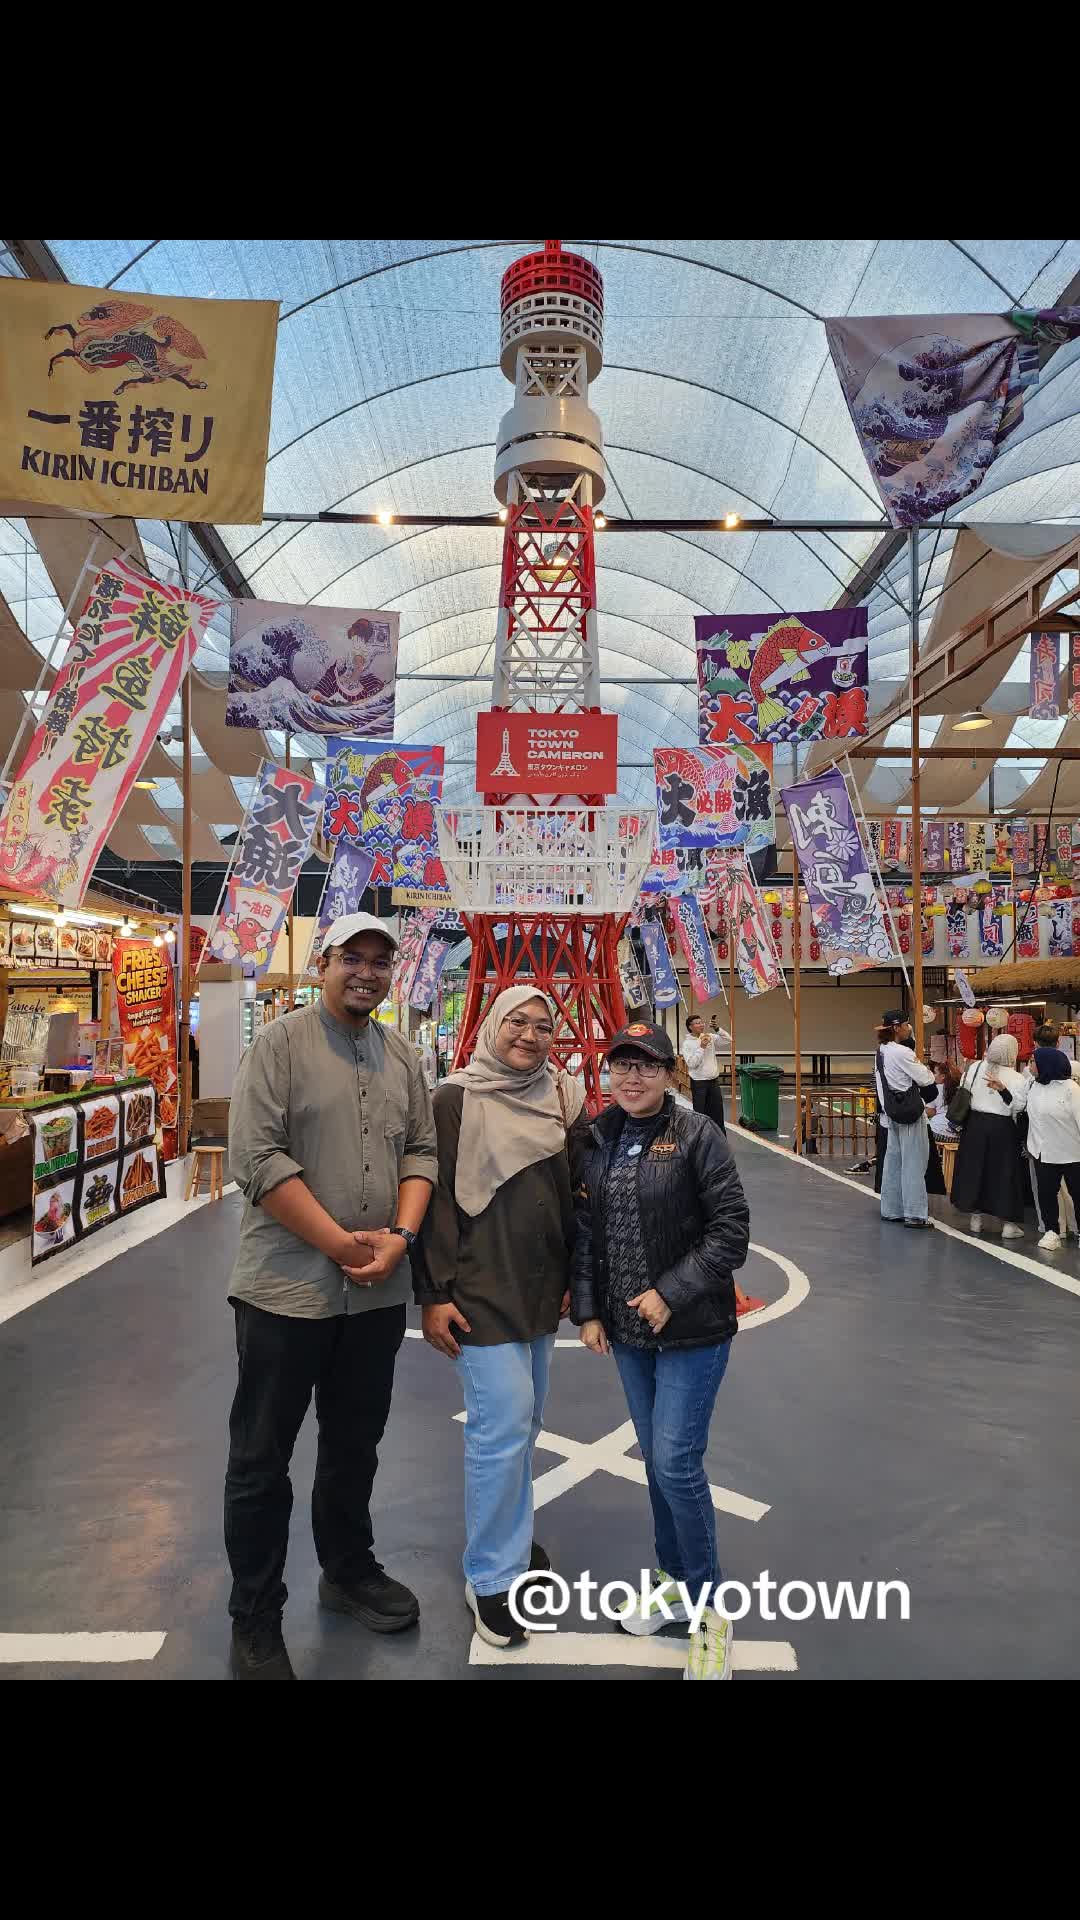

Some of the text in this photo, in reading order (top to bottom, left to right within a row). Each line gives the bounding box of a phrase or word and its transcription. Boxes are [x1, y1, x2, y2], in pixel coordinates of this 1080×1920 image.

[27, 399, 215, 463] 一番搾り
[21, 446, 209, 495] KIRIN ICHIBAN
[527, 728, 580, 738] TOKYO
[527, 740, 574, 749] TOWN
[527, 751, 604, 760] CAMERON
[406, 891, 452, 901] KIRIN ICHIBAN
[122, 948, 162, 973] FRIES
[116, 966, 168, 994] CHEESE
[126, 987, 162, 1005] SHAKER
